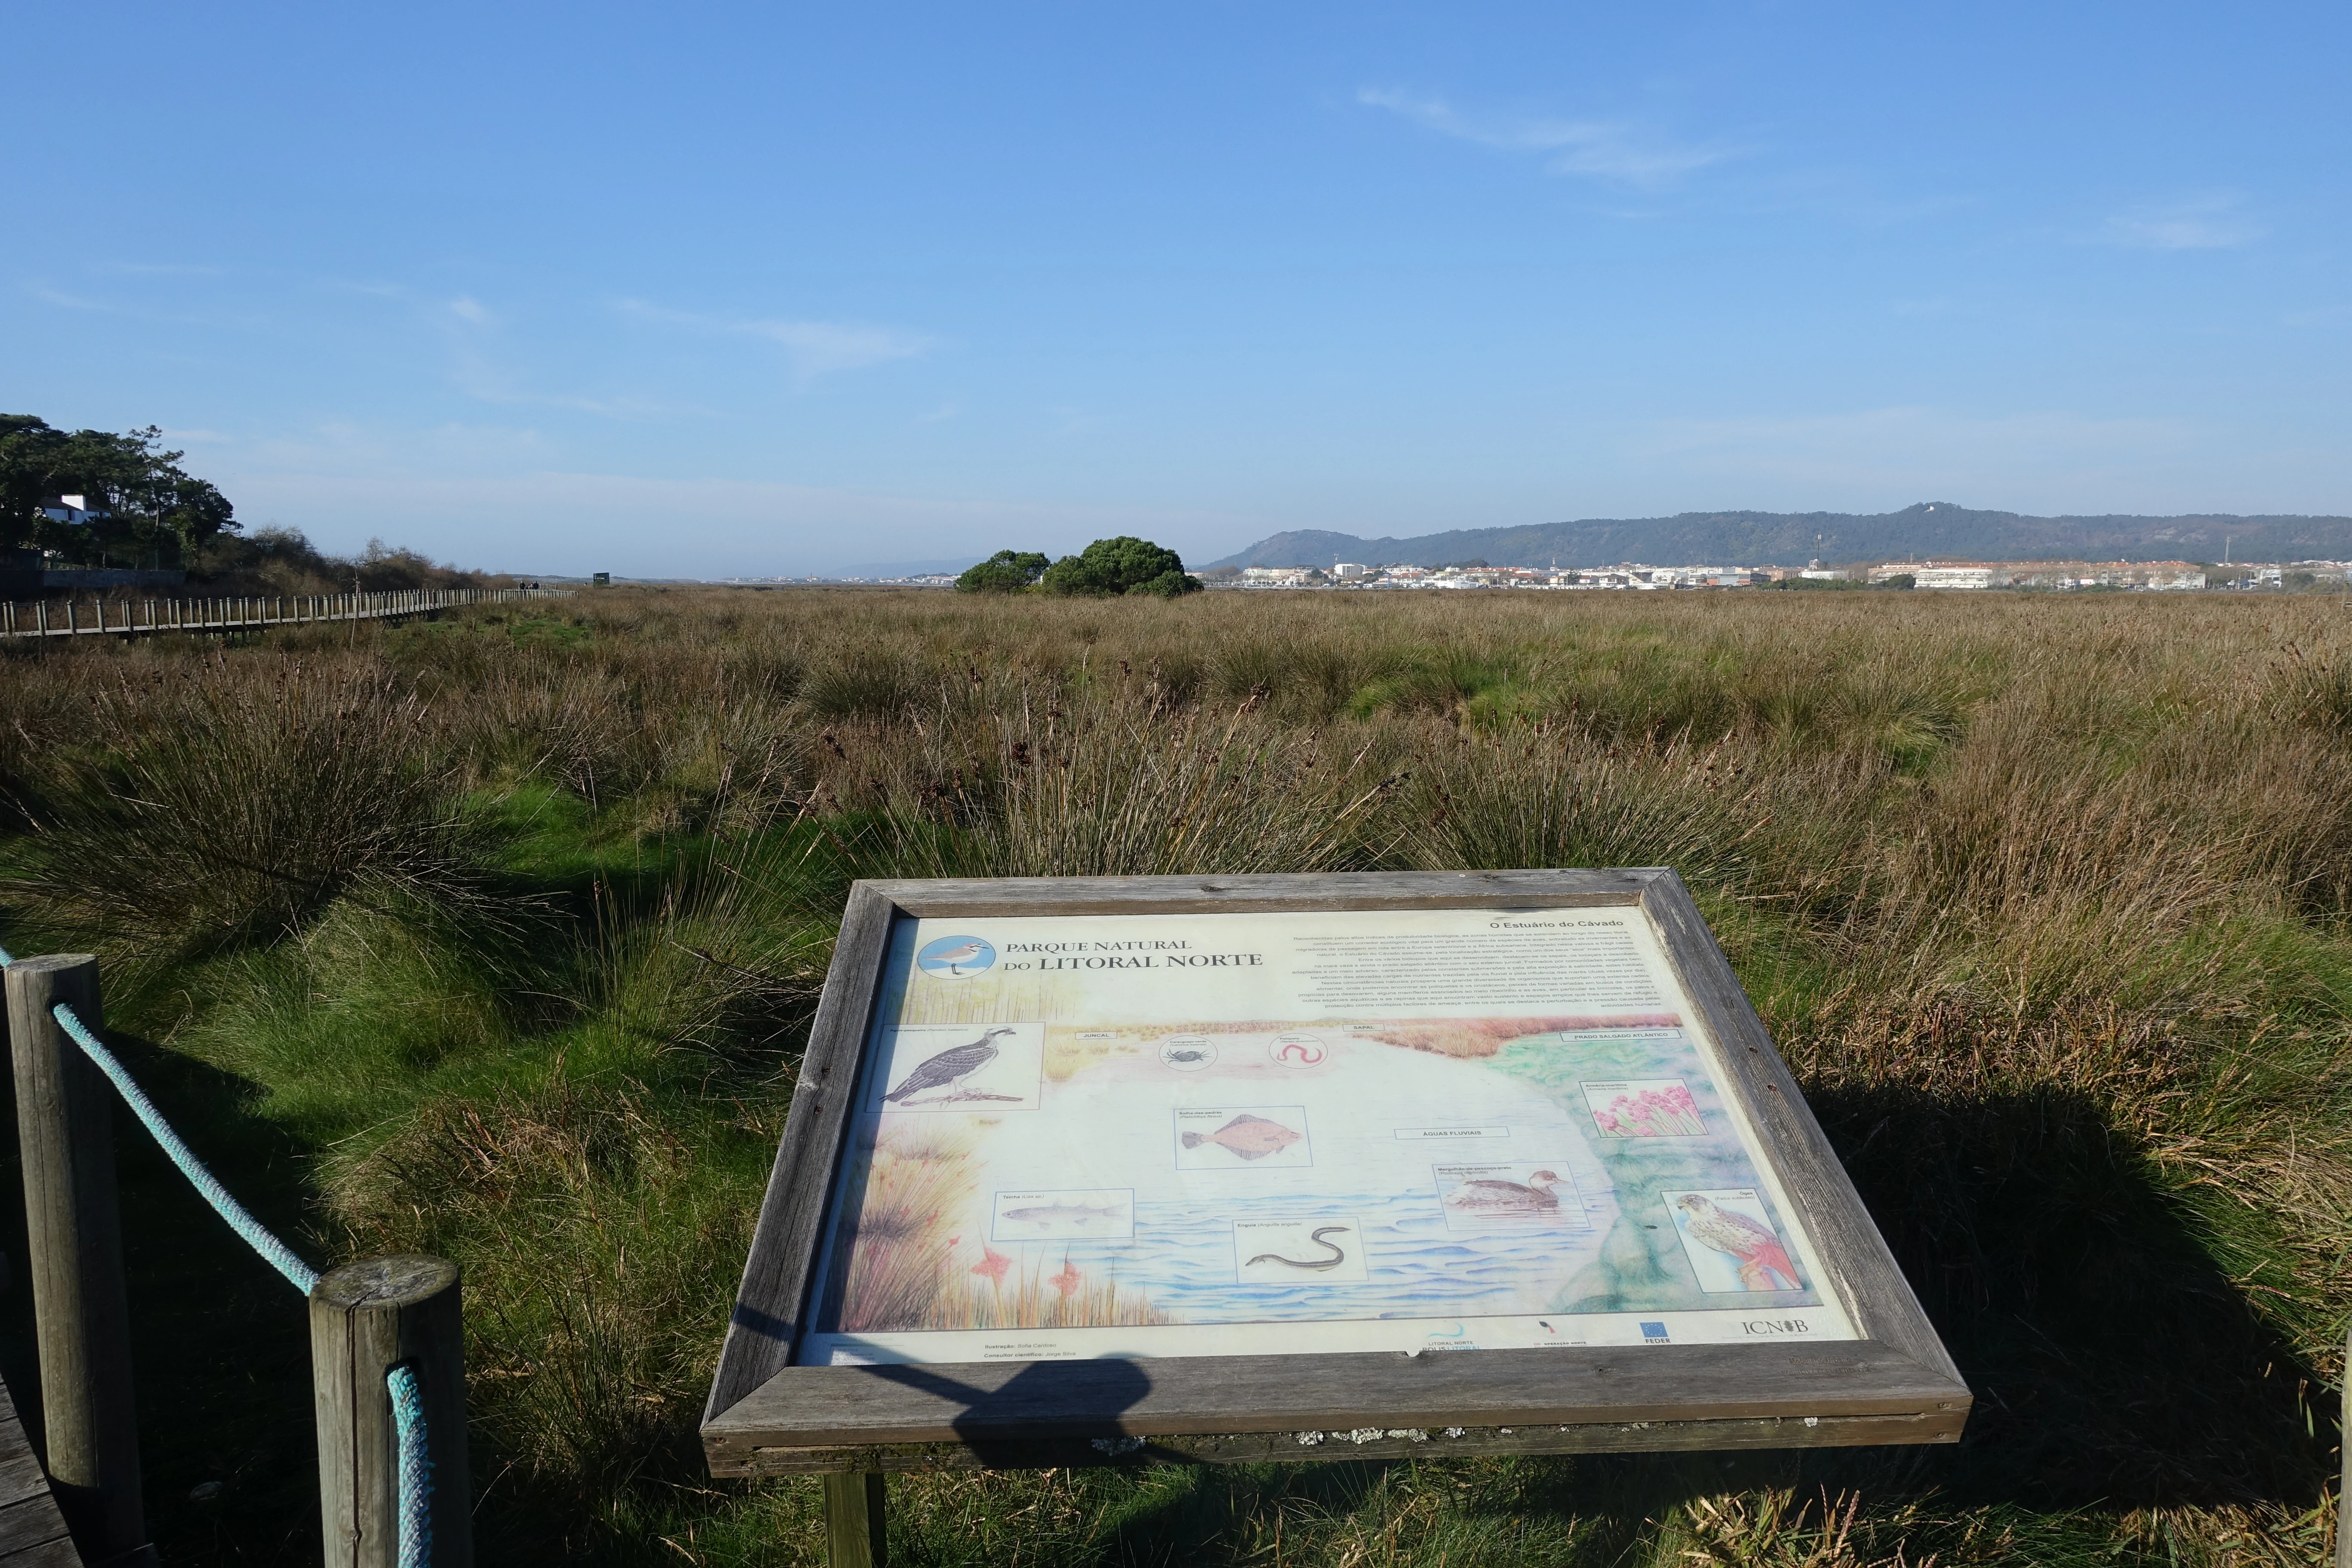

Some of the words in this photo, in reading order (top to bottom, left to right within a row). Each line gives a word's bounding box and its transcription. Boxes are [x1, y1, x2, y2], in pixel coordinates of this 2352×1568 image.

[1006, 943, 1087, 954] PARQUE
[1094, 941, 1191, 950] NATURAL
[1038, 957, 1158, 969] LITORAL
[1166, 954, 1262, 967] NORTE
